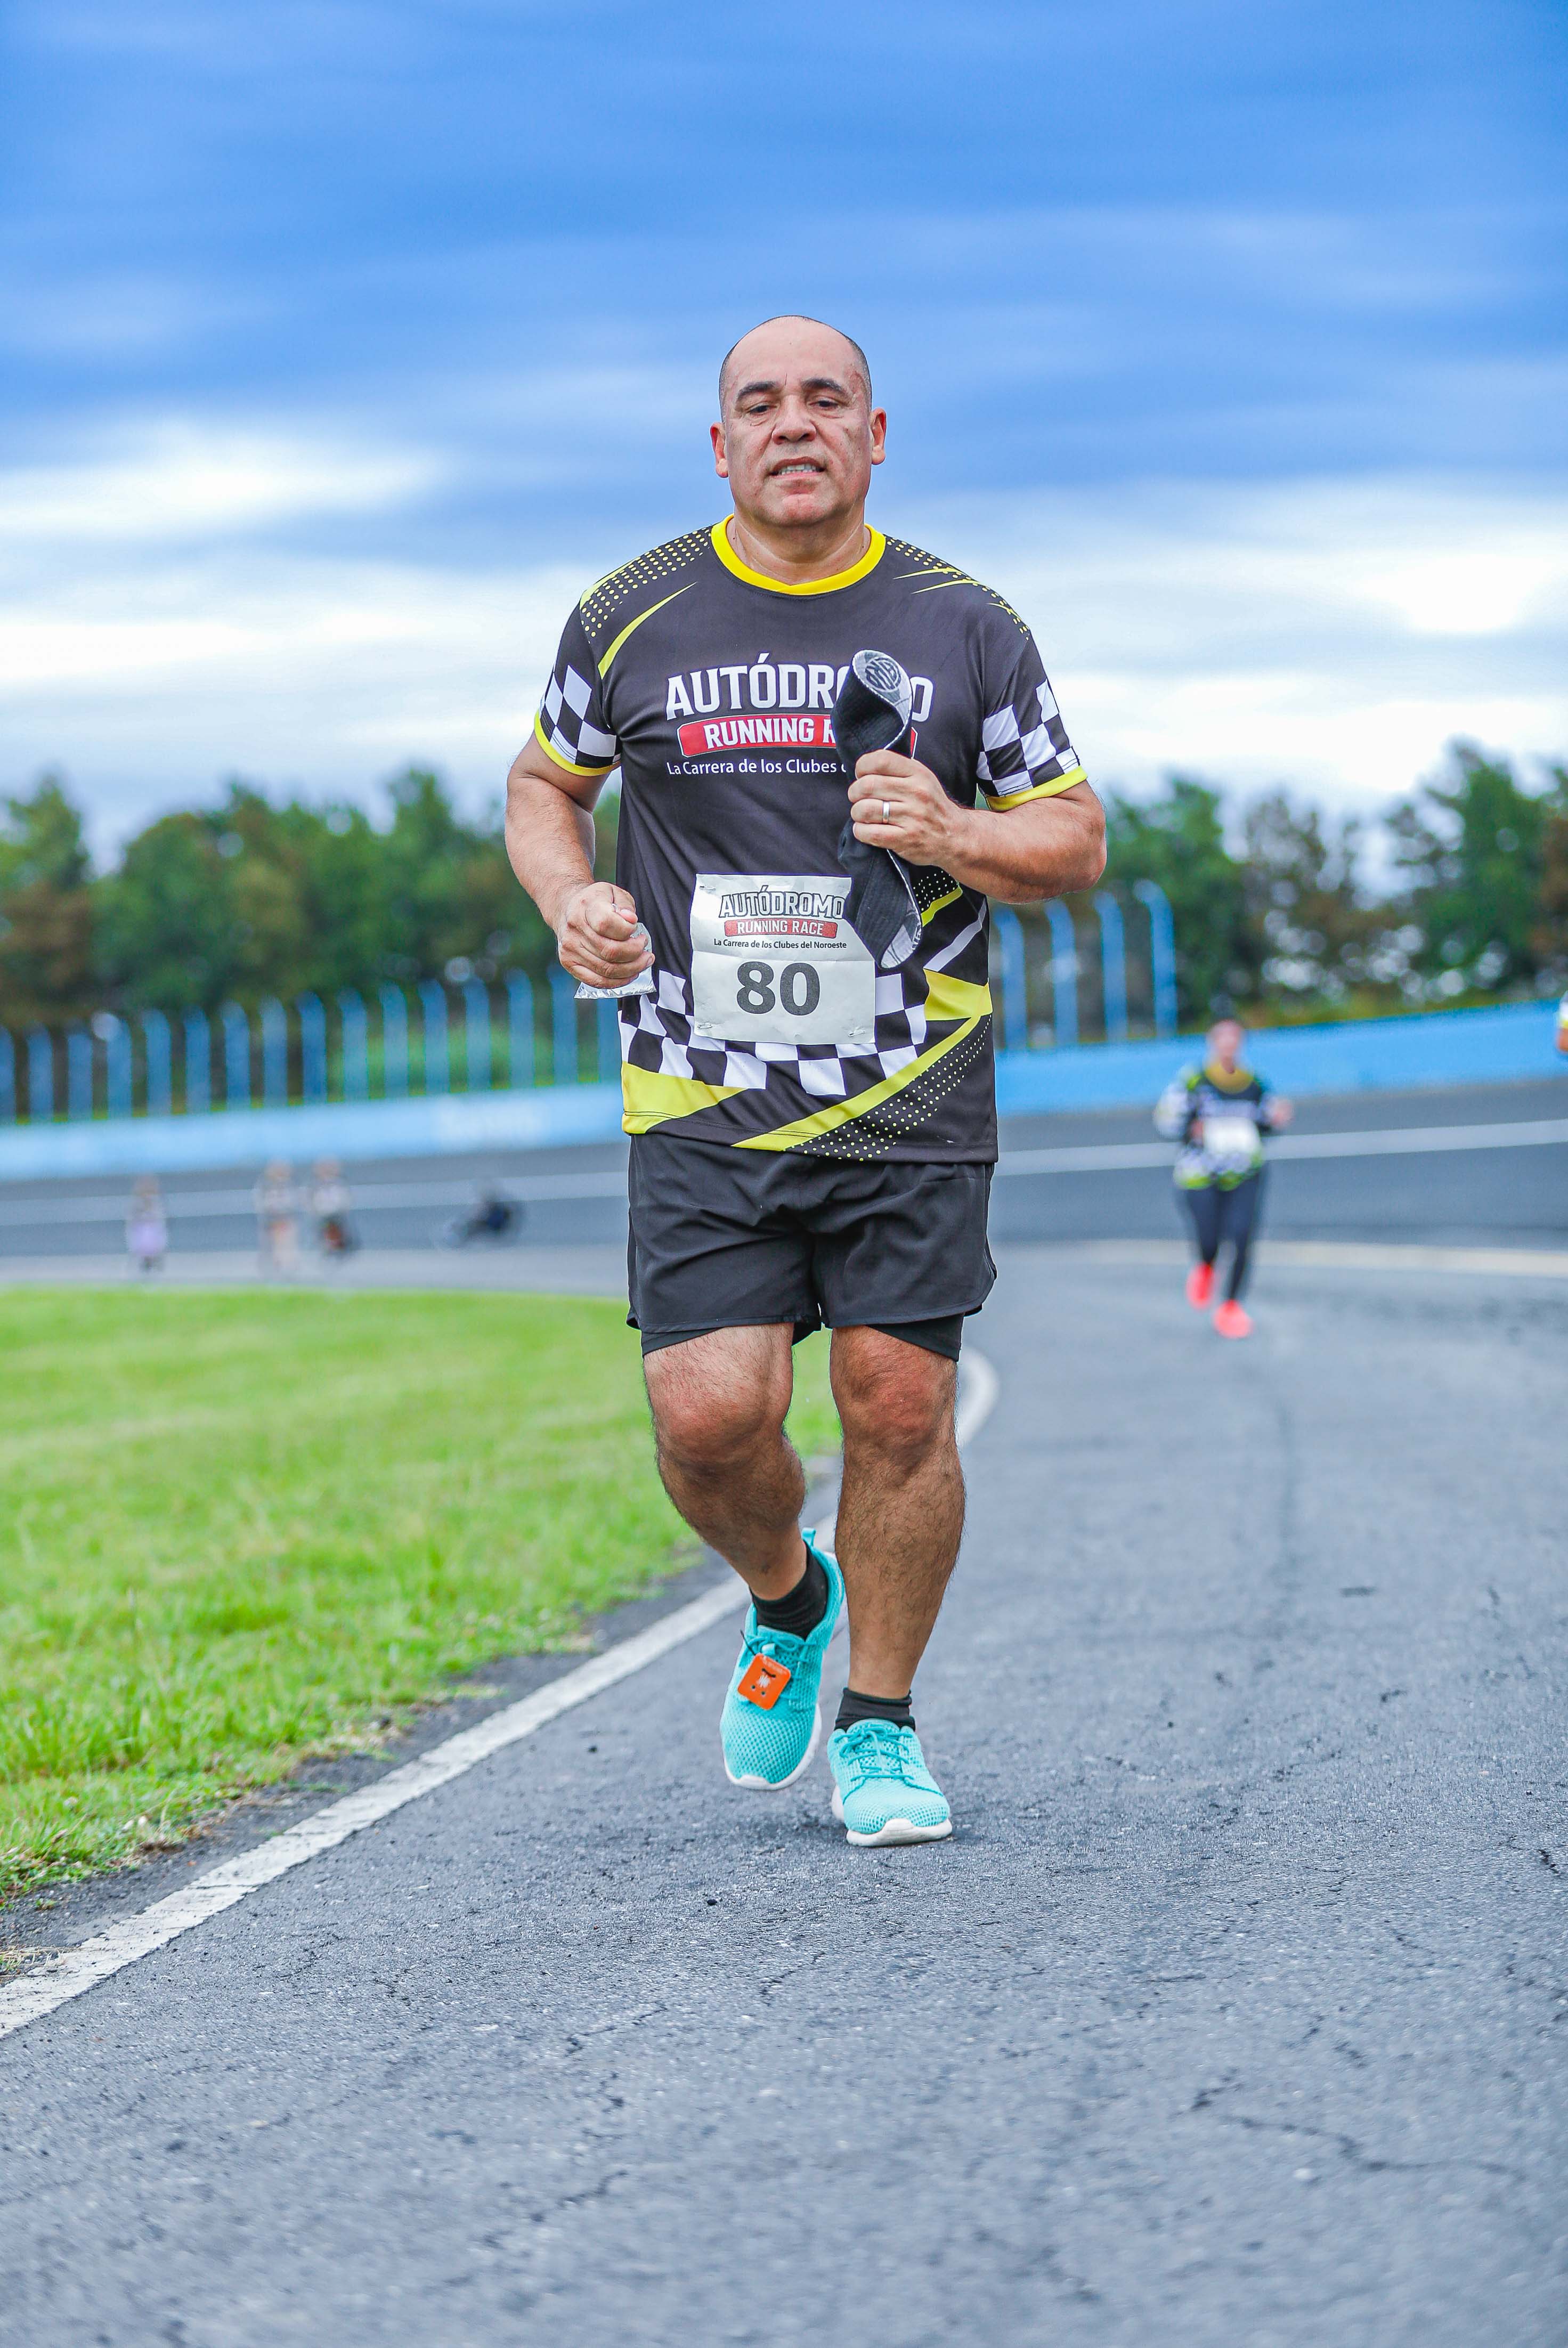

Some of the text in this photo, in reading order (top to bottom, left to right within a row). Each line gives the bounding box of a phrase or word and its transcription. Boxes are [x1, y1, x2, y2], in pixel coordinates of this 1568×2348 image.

[665, 653, 933, 722] AUTÓDRO
[703, 718, 815, 749] RUNNING
[667, 762, 681, 775] La
[683, 761, 734, 775] Carrera
[738, 759, 757, 774] de
[760, 759, 782, 774] los
[785, 758, 837, 773] Clubes
[718, 885, 846, 920] AUTÓDROMO
[723, 939, 749, 947] Carrera
[737, 920, 824, 936] RUNNING RACE
[736, 961, 820, 1016] 80
